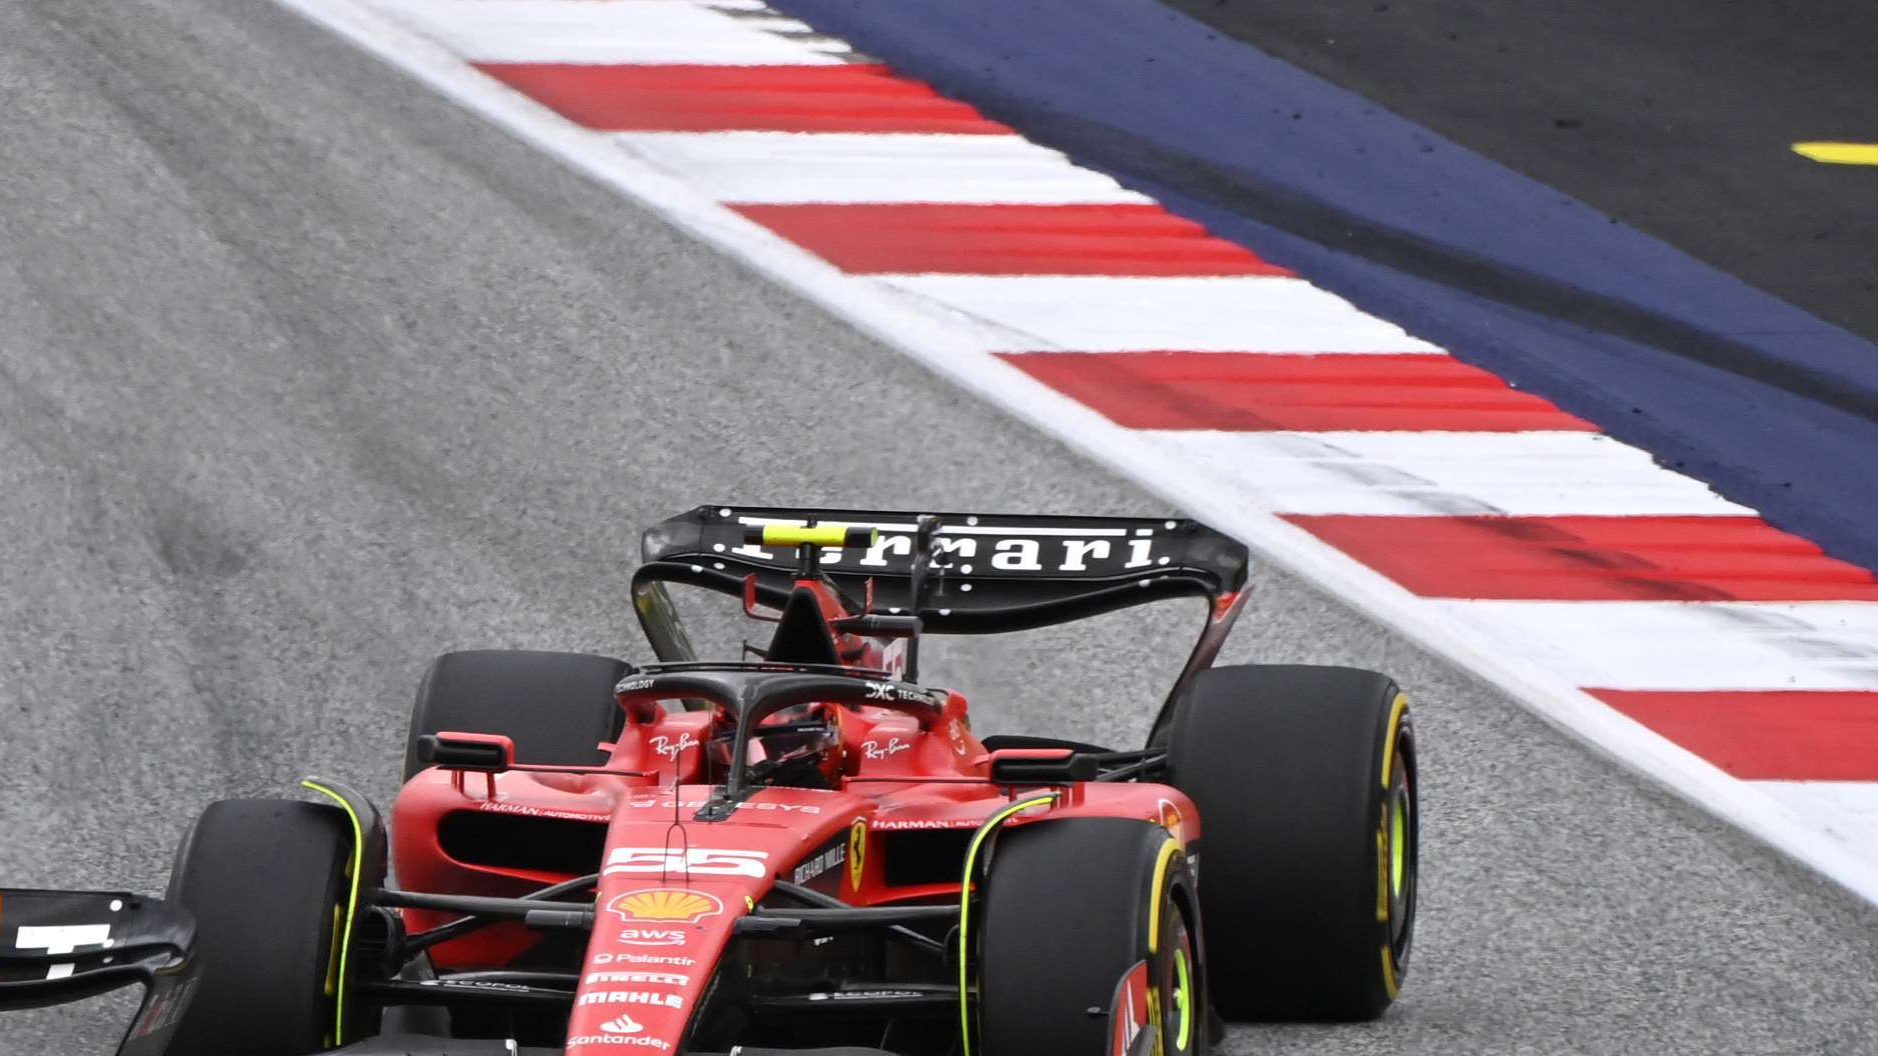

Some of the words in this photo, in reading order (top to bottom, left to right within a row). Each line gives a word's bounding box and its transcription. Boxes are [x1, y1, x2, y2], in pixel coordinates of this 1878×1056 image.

[730, 513, 1152, 573] rrari
[649, 732, 700, 762] Ray-Ban
[861, 738, 911, 760] Ray-Ban
[662, 799, 821, 815] GEESYS
[872, 820, 949, 829] HARMAN
[603, 847, 770, 878] 55
[619, 929, 686, 941] aws
[616, 954, 697, 967] Palantir
[585, 971, 691, 987] PIRELLI
[578, 991, 684, 1009] MAHLE
[565, 1034, 673, 1051] Santander
